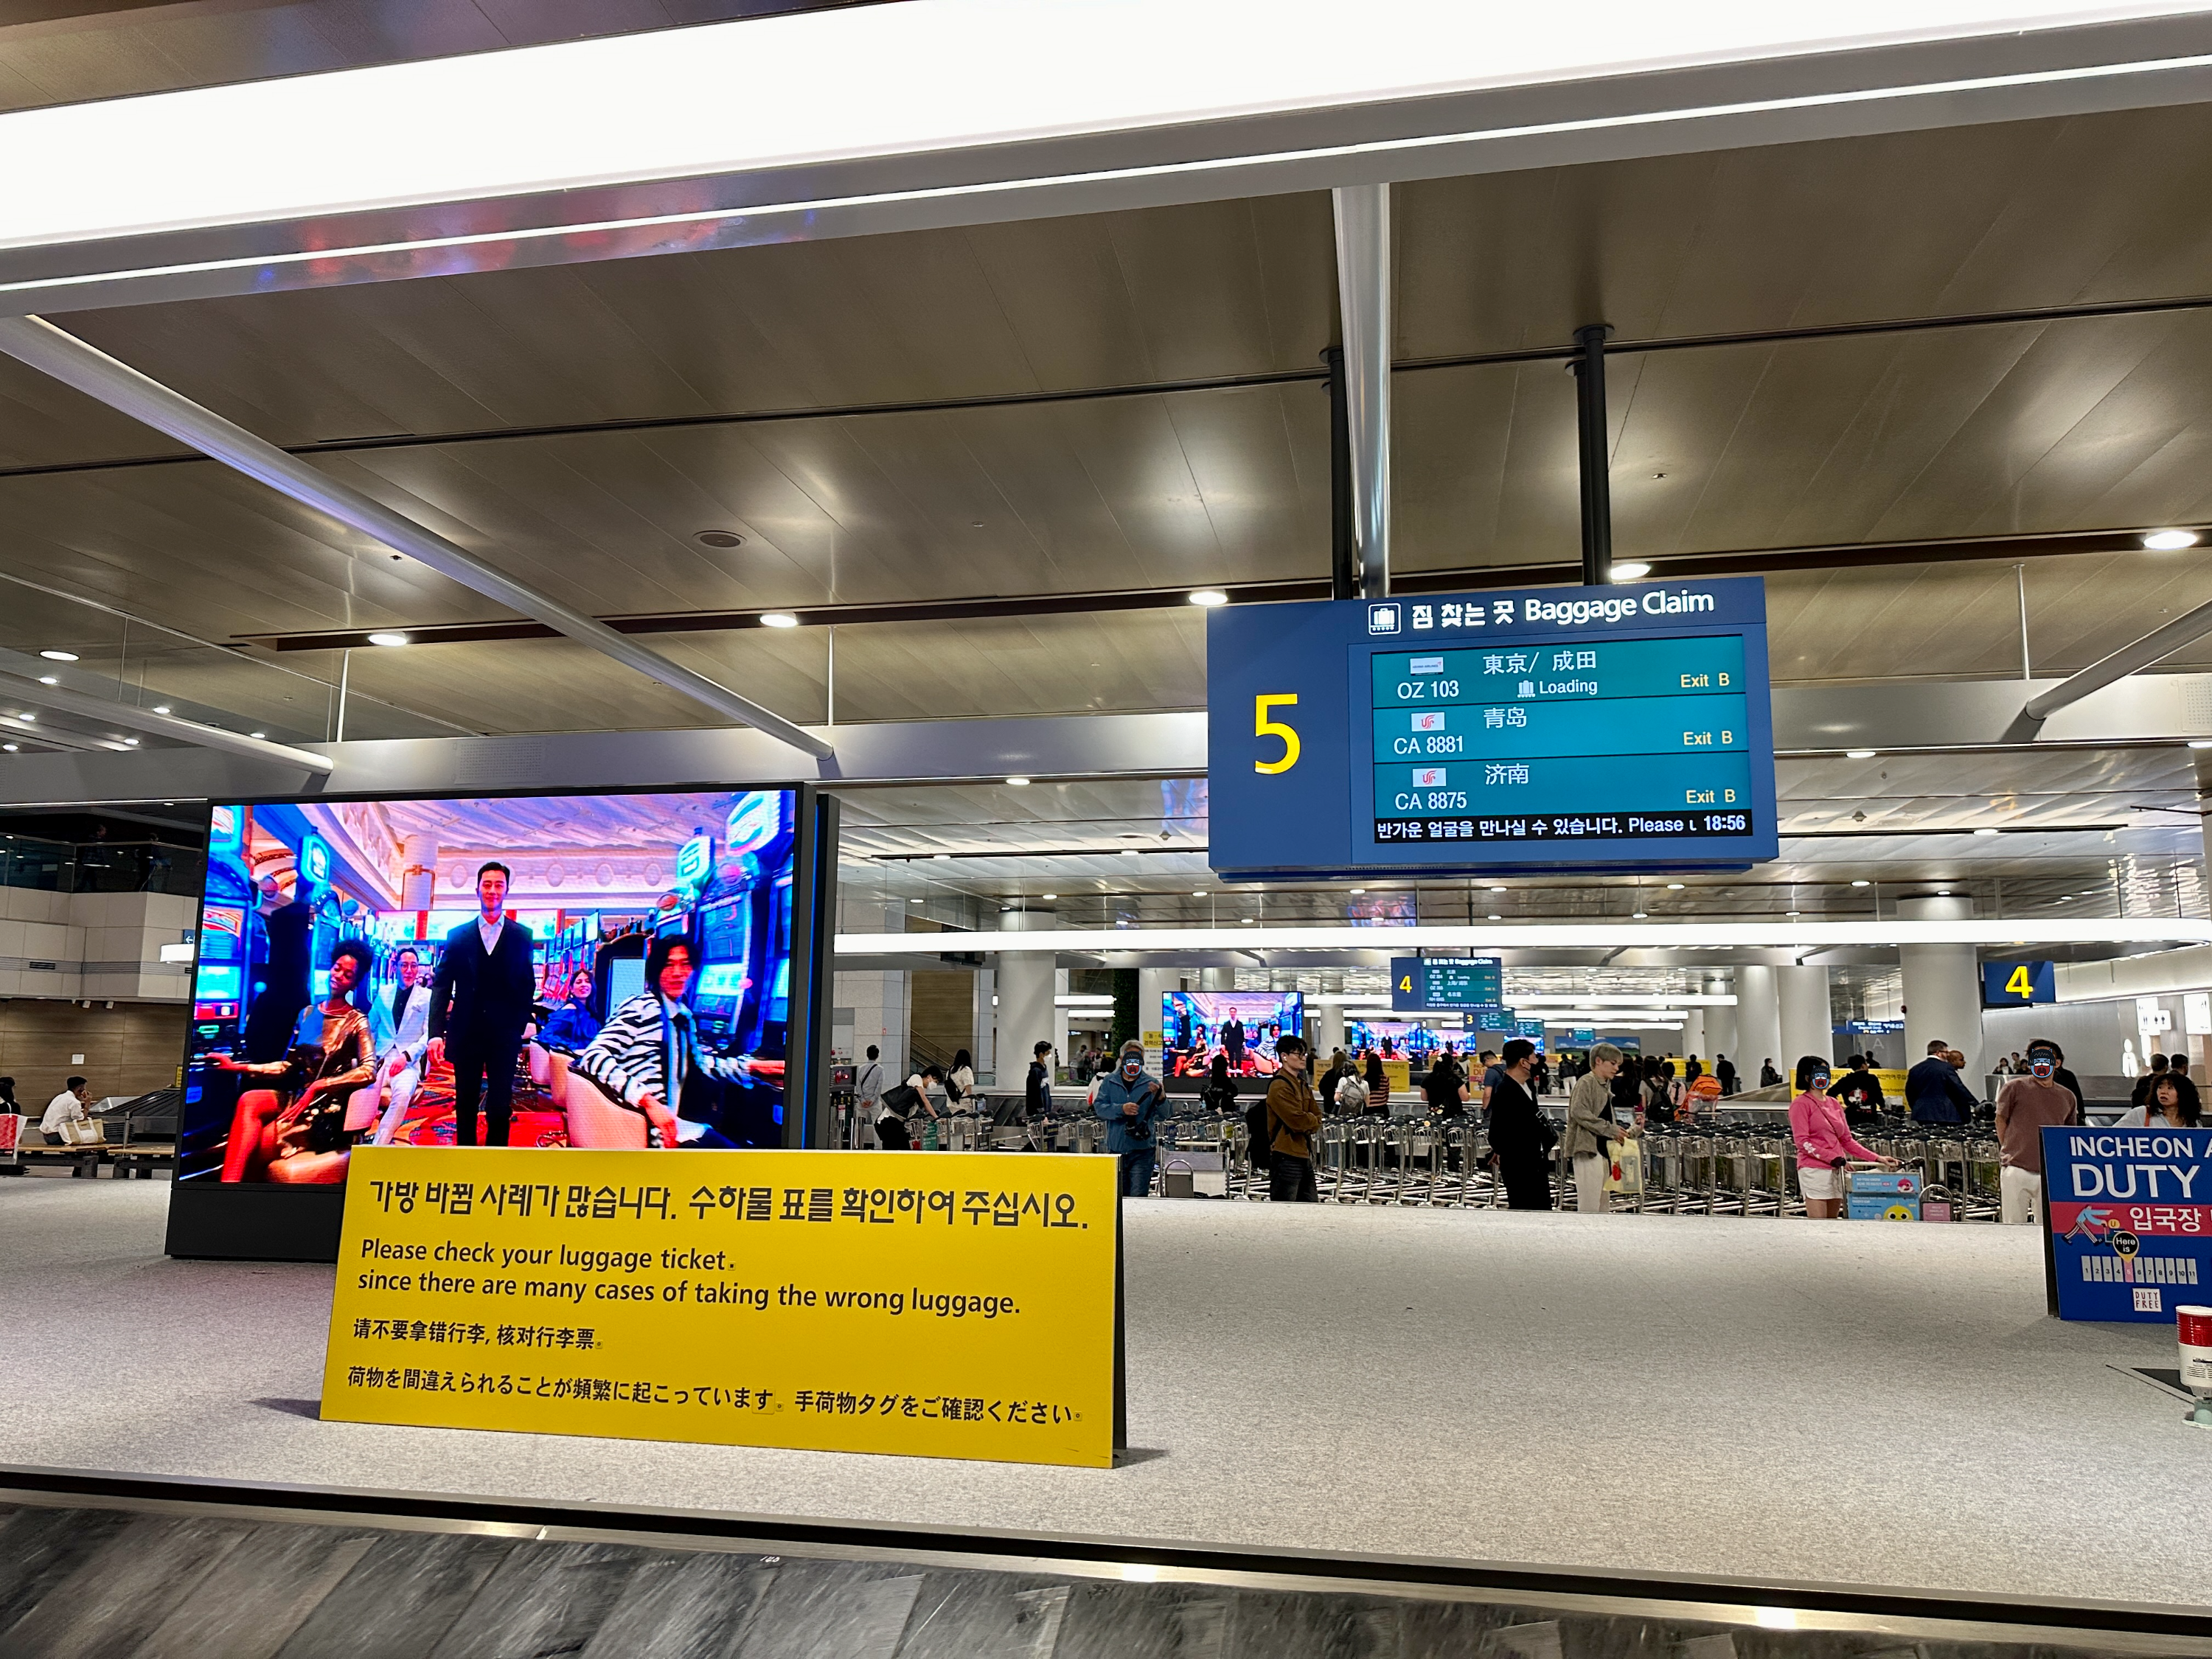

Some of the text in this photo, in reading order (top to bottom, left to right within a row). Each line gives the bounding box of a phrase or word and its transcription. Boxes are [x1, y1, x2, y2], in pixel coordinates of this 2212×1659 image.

[1412, 589, 1714, 630] 짐 찾는 곳 Baggage Claim
[1483, 650, 1596, 675] 東京/ 成田
[1397, 680, 1459, 700] OZ 103
[1539, 678, 1598, 695] Loading
[1680, 672, 1730, 688] Exit B
[1483, 706, 1527, 729] 青岛
[1254, 693, 1301, 775] 5
[1683, 730, 1733, 745] Exit B
[1394, 735, 1463, 755] CA 8881
[1484, 762, 1530, 785] 济南
[1395, 791, 1467, 810] CA 8875
[1686, 788, 1736, 804] Exit B
[1377, 821, 1423, 839] 반가운
[1427, 820, 1475, 838] 얼굴을
[1479, 819, 1526, 837] 만나실
[1531, 819, 1548, 835] 수
[1553, 817, 1623, 835] 있습니다.
[1628, 817, 1684, 832] Please
[1703, 814, 1746, 831] 18:56
[1399, 975, 1413, 993] 4
[2005, 965, 2034, 999] 4
[1466, 1014, 1474, 1025] 3
[1872, 1037, 1885, 1049] A
[2070, 1136, 2194, 1158] INCHEON
[2071, 1164, 2200, 1198] DUTY
[369, 1180, 1088, 1229] 가방 바뀜 사례가 많습니다. 수하물 표를 확인하여 주십시오.
[2129, 1206, 2202, 1232] 입국장
[2115, 1237, 2136, 1245] Here
[2122, 1245, 2130, 1253] is
[361, 1237, 734, 1273] Please check your luggage ticket.
[358, 1268, 1020, 1319] since there are many cases of taking the wrong luggage.
[2135, 1290, 2158, 1300] DUTY
[2135, 1300, 2159, 1310] FREE
